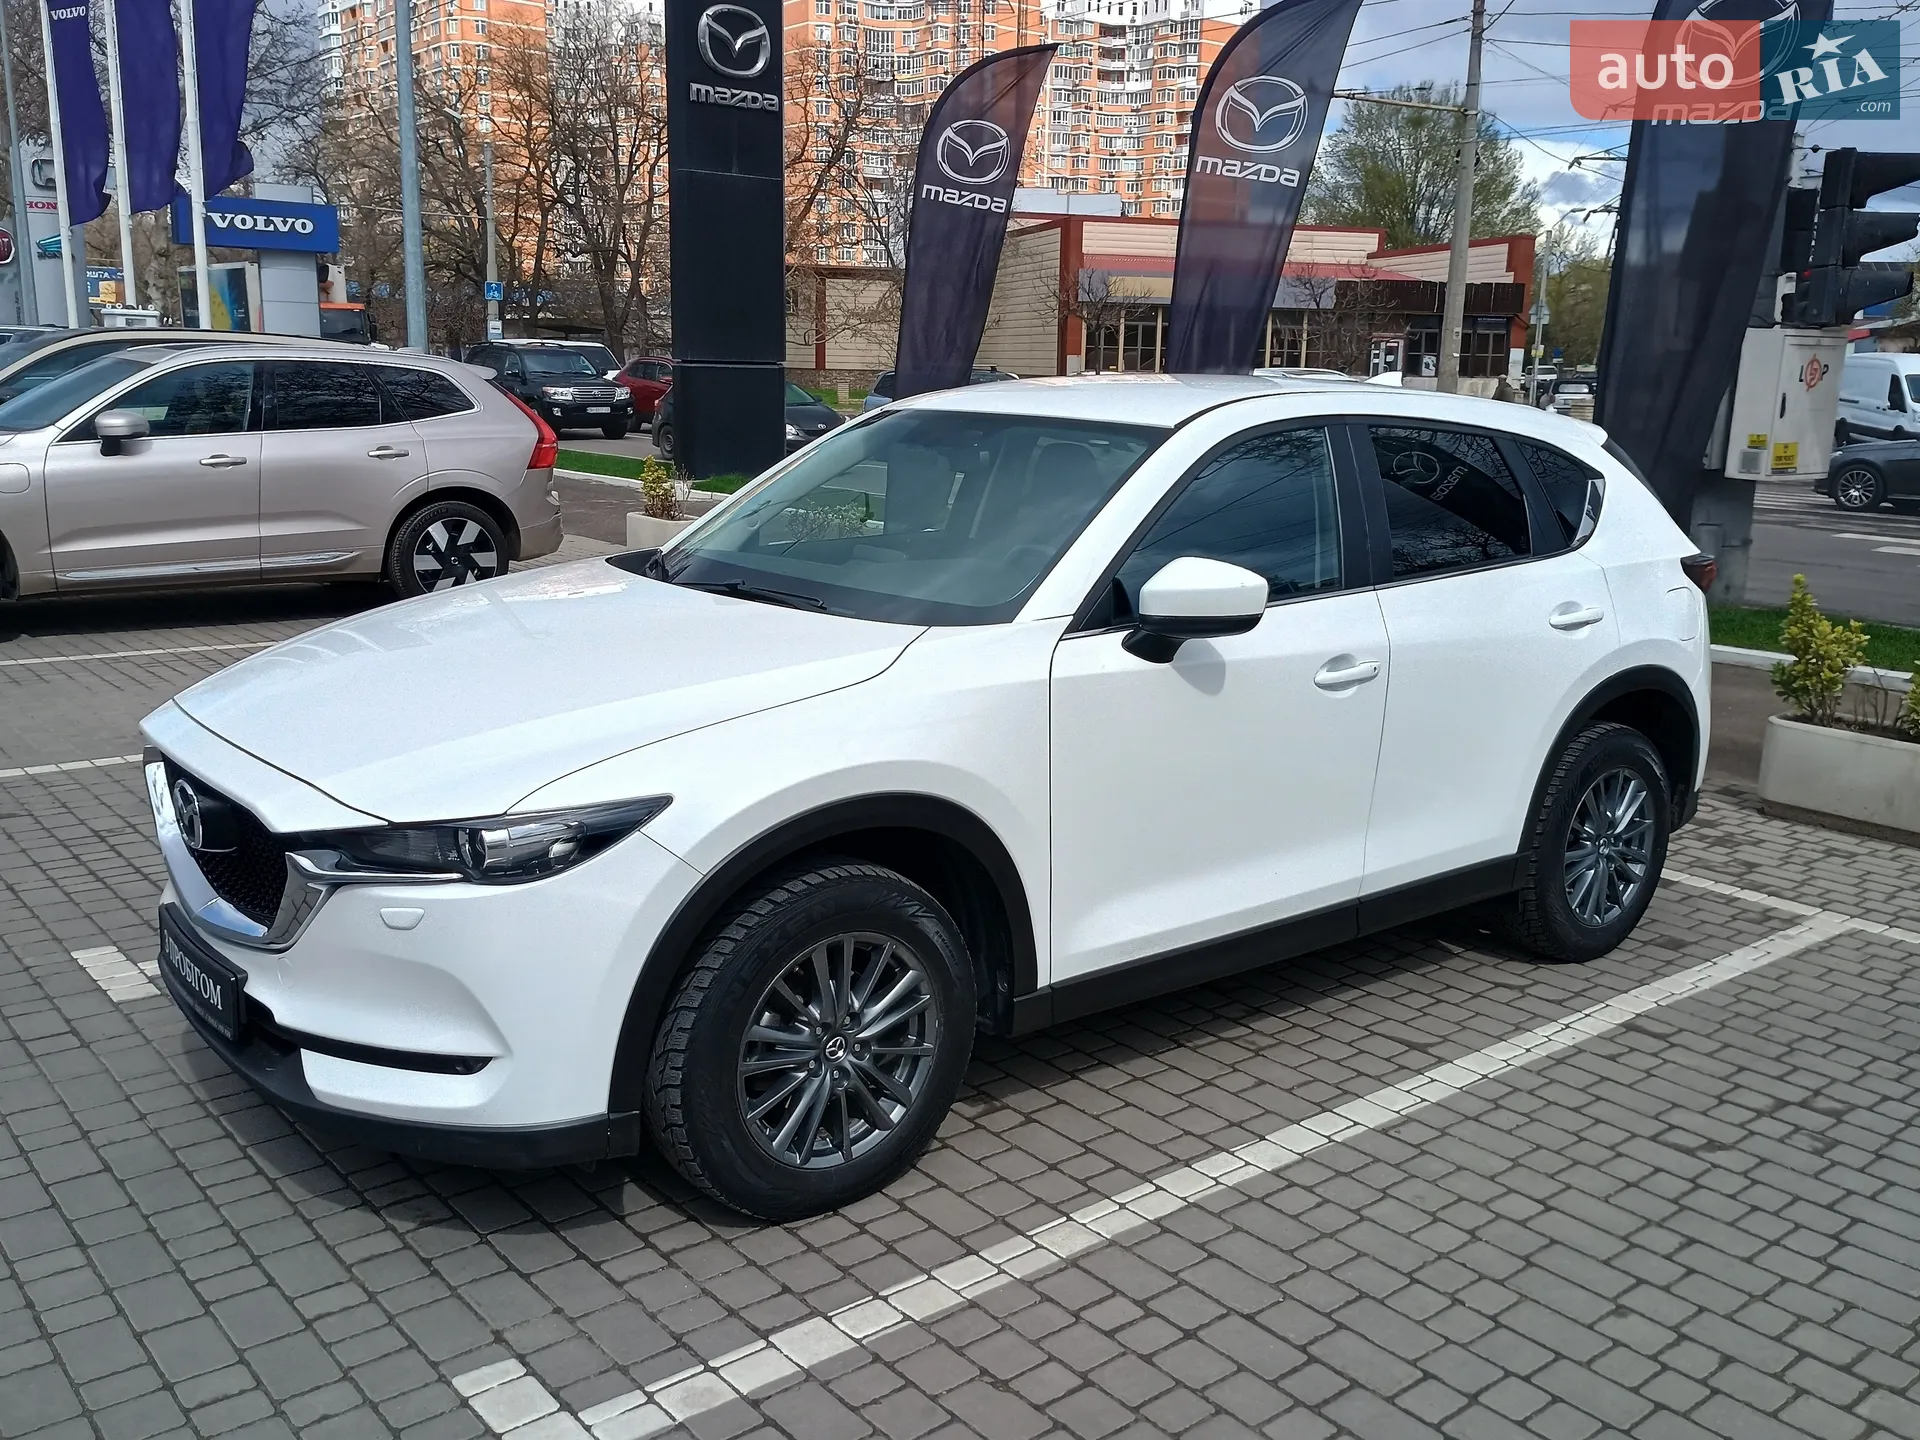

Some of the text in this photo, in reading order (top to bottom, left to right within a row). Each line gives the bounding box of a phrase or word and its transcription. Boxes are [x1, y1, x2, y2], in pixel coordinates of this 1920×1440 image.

[50, 6, 86, 21] VOLVO
[688, 82, 780, 112] mazda
[1196, 156, 1301, 188] mazda
[922, 184, 1007, 214] mazda
[207, 213, 314, 234] VOLVO
[164, 929, 170, 954] З
[169, 936, 223, 1011] ПРОБІГОМ
